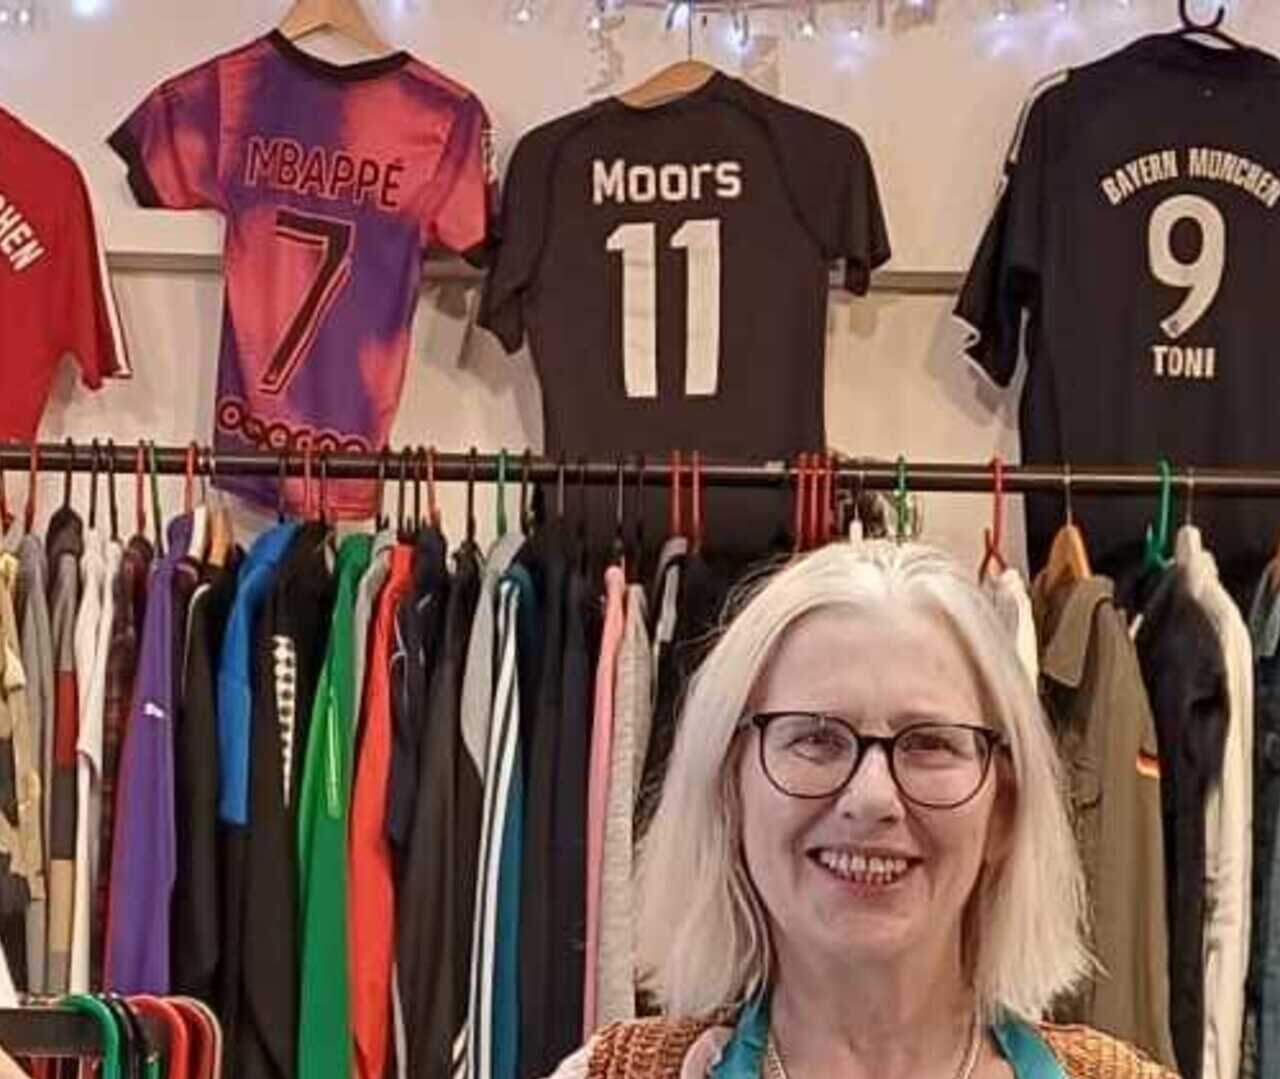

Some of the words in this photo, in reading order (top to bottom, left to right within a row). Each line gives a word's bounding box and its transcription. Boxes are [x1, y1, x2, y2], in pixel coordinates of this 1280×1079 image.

[244, 135, 406, 211] MBAPPÉ
[592, 159, 742, 205] Moors
[1101, 150, 1179, 206] BAYERN
[257, 206, 356, 396] 7
[1148, 194, 1225, 339] 9
[606, 218, 721, 398] 11
[1152, 345, 1216, 378] TONI
